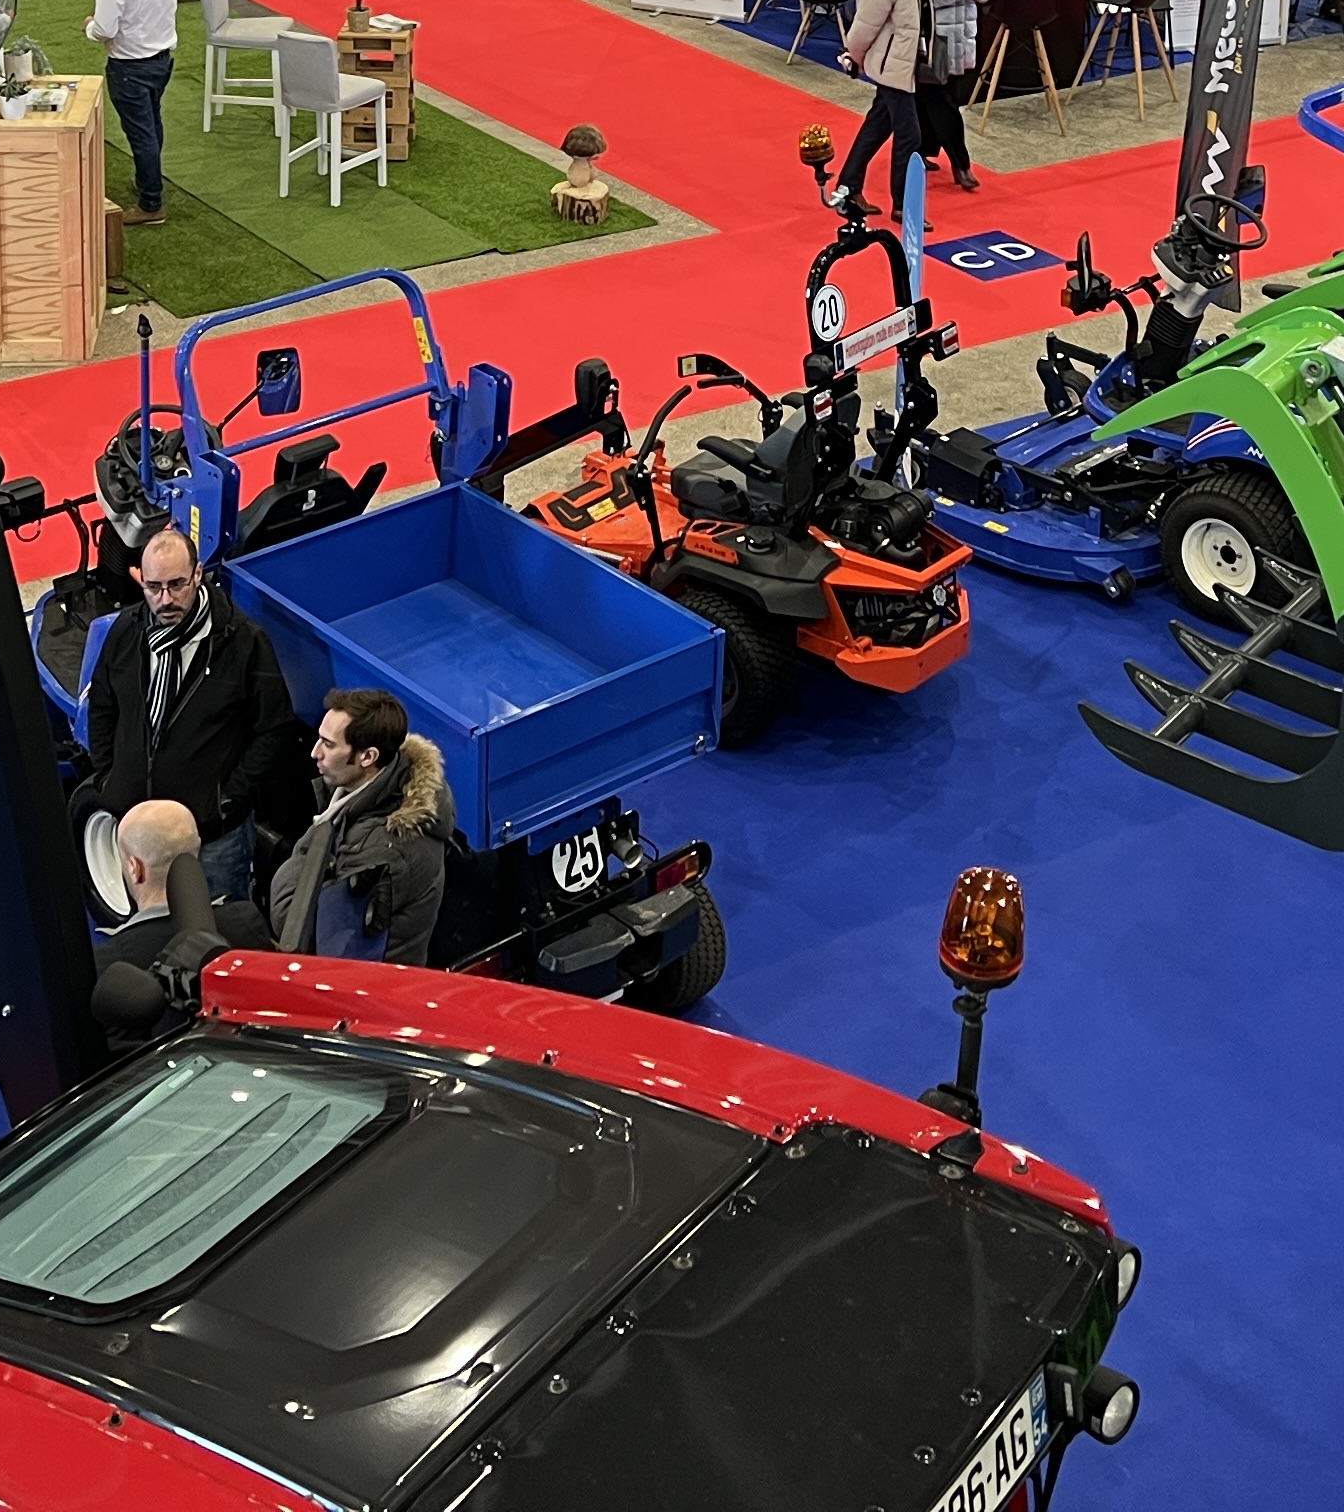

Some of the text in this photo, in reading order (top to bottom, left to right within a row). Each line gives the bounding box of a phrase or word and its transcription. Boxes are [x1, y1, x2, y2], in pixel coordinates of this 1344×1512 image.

[950, 242, 1036, 270] C D
[818, 294, 840, 333] 20
[559, 834, 601, 889] 25
[1033, 1409, 1048, 1447] 54
